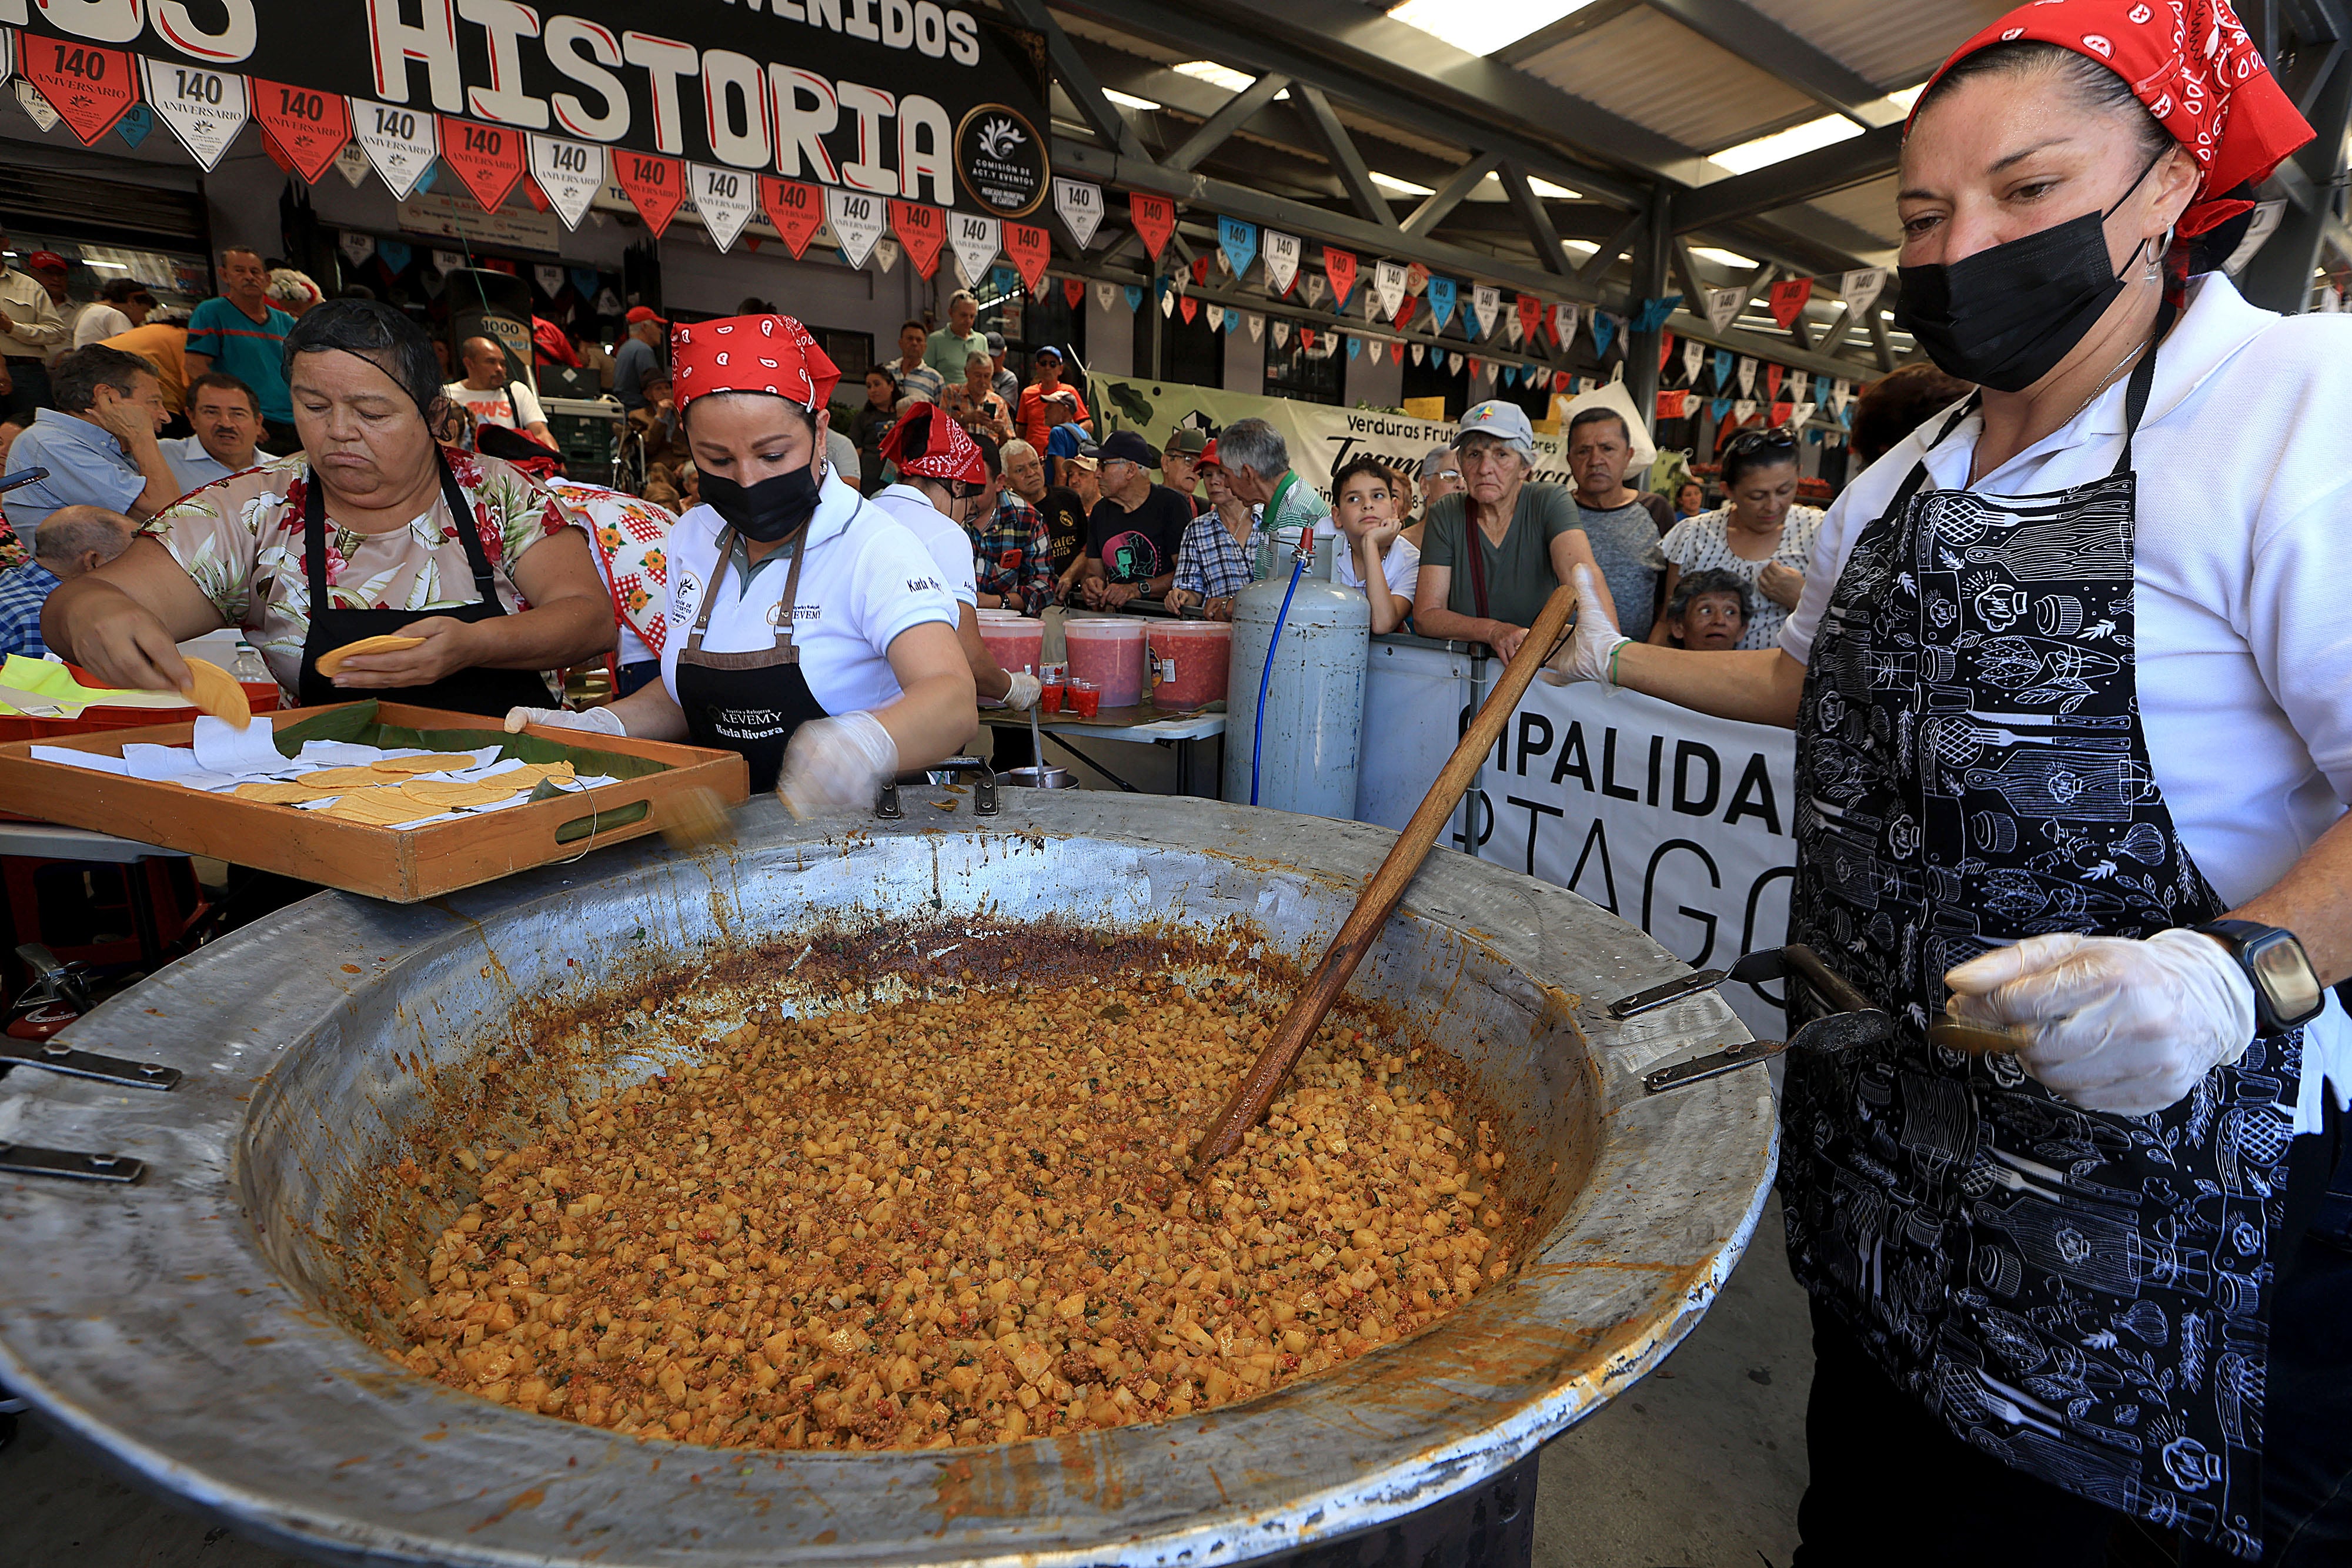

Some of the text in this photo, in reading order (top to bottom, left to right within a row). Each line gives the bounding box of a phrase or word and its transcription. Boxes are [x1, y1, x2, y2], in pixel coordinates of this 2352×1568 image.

[722, 0, 980, 67] NIDOS
[55, 45, 105, 81] 140
[31, 88, 44, 101] 14
[34, 73, 126, 99] ANIVERSARIO
[176, 70, 223, 105] 140
[161, 101, 242, 121] ANIVERSARIO
[280, 89, 323, 121] 140
[366, 0, 956, 208] HISTORIA
[267, 116, 341, 137] ANIVERSARIO
[376, 108, 415, 140] 140
[363, 135, 431, 155] ANIVERSARIO
[465, 126, 501, 156] 140
[343, 148, 361, 162] 140
[452, 152, 516, 170] ANIVERSARIO
[553, 143, 587, 173] 140
[633, 158, 665, 185] 140
[975, 158, 1030, 176] COMISIÓN DE
[542, 170, 600, 185] ANIVERSARIO
[709, 172, 738, 198] 140
[999, 172, 1034, 186] EVENTOS
[624, 182, 678, 199] ANIVERSARIO
[779, 184, 806, 208] 140
[1068, 186, 1089, 206] 140
[698, 196, 749, 210] ANIVERSARIO
[844, 196, 870, 219] 140
[1144, 202, 1162, 220] 140
[770, 206, 817, 220] ANIVERSARIO
[906, 206, 930, 228] 140
[835, 218, 880, 231] ANIVERSARIO
[963, 218, 986, 240] 140
[1018, 228, 1040, 248] 140
[1230, 225, 1246, 244] 140
[1277, 238, 1292, 256] 140
[1332, 255, 1347, 272] 140
[1387, 269, 1401, 285] 140
[1855, 273, 1876, 290] 140
[1435, 282, 1448, 297] 140
[1481, 291, 1494, 306] 140
[1782, 285, 1802, 300] 140
[483, 320, 519, 334] 1000
[1347, 414, 1419, 439] Verduras
[906, 577, 929, 593] Karla
[793, 610, 821, 620] EVEM
[721, 711, 783, 725] KEVEMY
[716, 724, 784, 740] Karla Rivera
